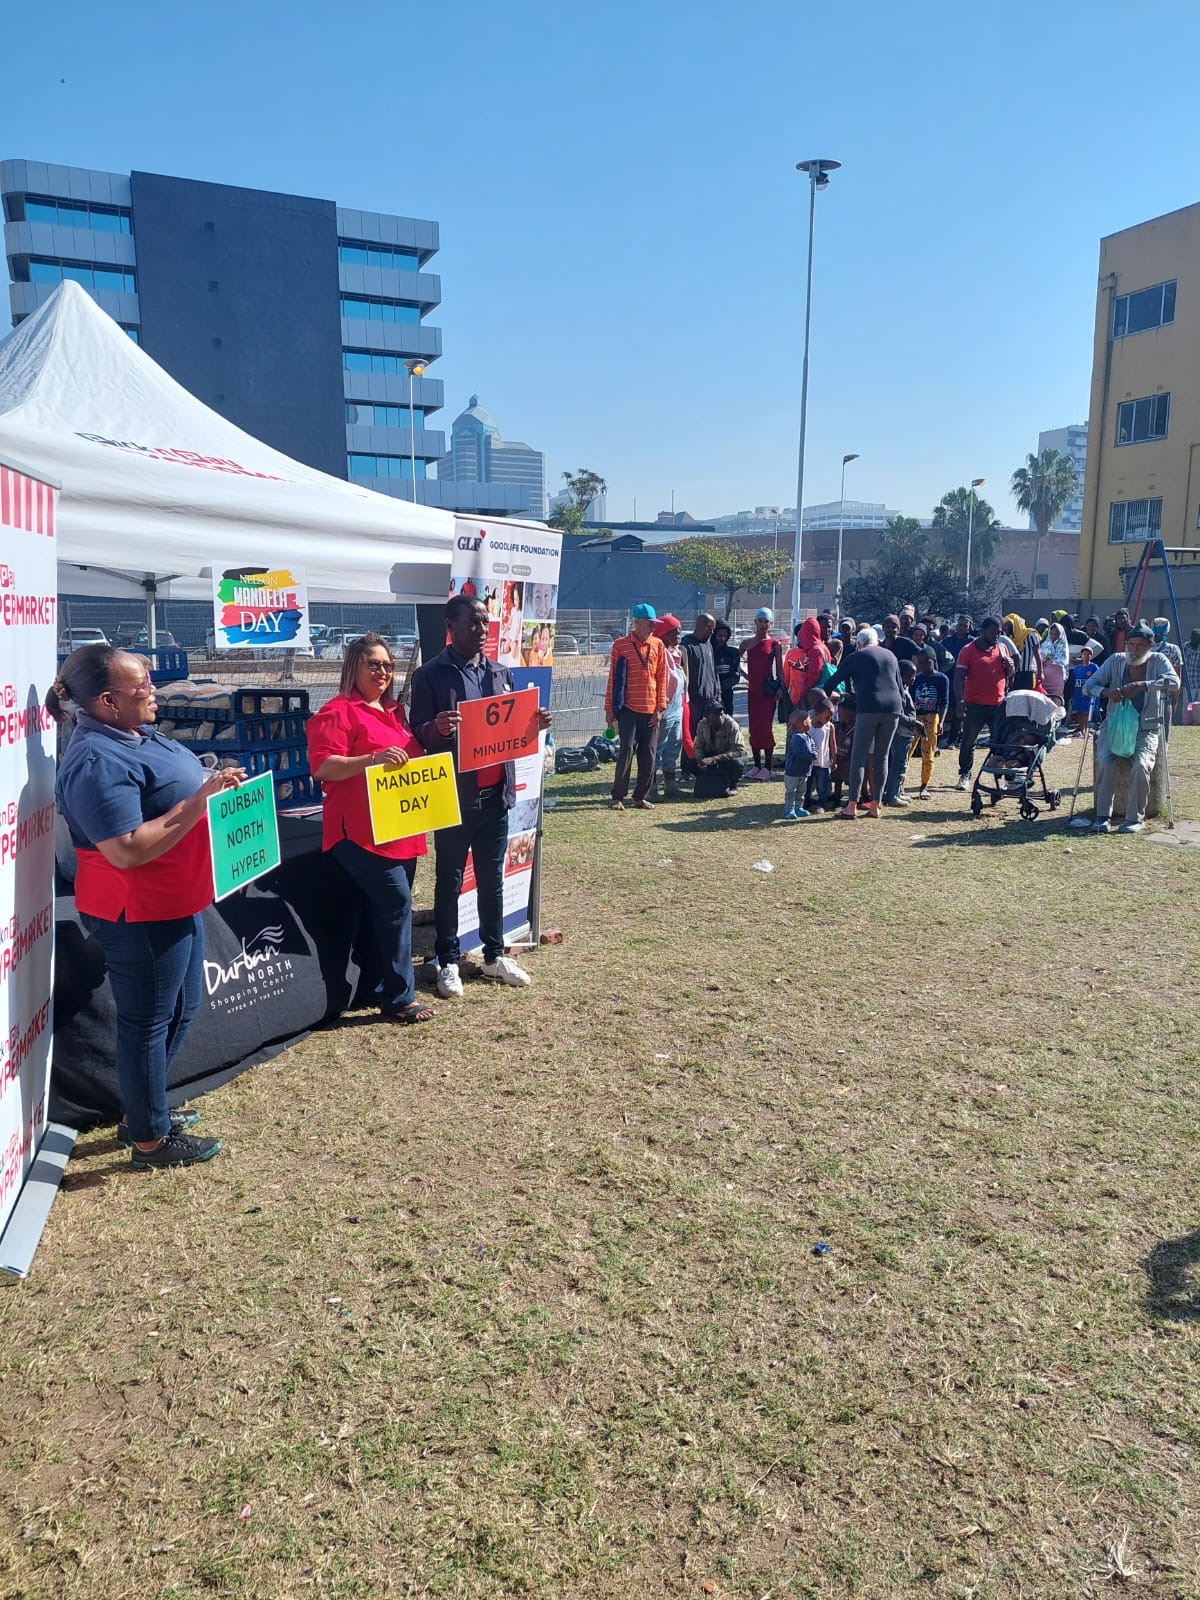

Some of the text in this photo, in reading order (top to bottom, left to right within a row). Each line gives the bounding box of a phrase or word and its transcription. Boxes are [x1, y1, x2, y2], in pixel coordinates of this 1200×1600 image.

[457, 536, 482, 551] GLF
[490, 541, 559, 557] GOODLIFE FOUNDATION
[240, 574, 278, 584] NELSON
[233, 587, 287, 608] MANDELA
[240, 611, 283, 632] DAY
[485, 698, 515, 726] 67
[473, 736, 528, 759] MINUTES
[376, 766, 447, 791] MANDELA
[220, 786, 265, 819] DURBAN
[400, 795, 429, 814] DAY
[227, 817, 265, 849] NORTH
[231, 848, 267, 880] HYPER
[203, 937, 281, 996] Durban
[248, 960, 293, 984] NORTH
[210, 972, 295, 1010] Shopping Centre
